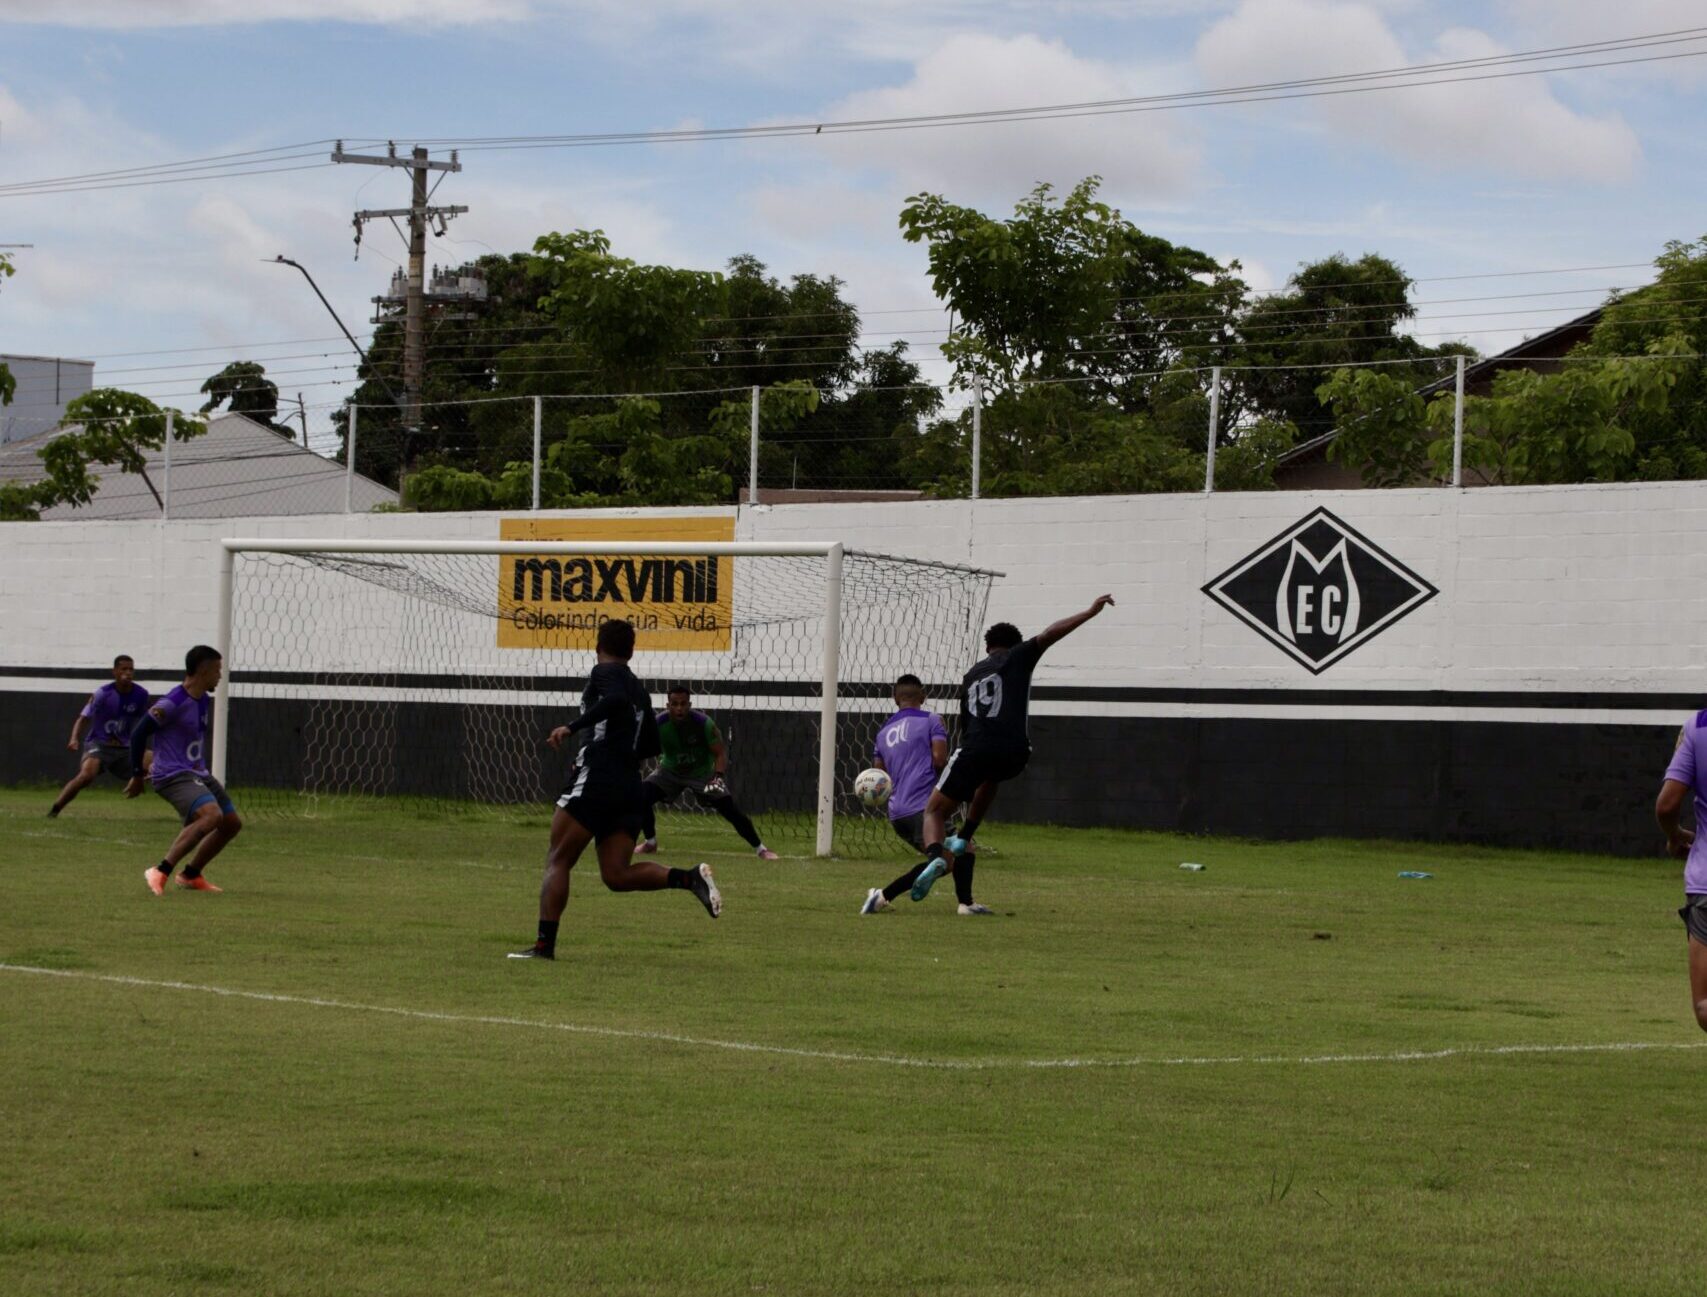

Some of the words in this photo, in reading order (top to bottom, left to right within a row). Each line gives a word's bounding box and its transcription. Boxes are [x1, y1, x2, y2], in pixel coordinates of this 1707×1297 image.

[513, 555, 718, 604] maxvinil
[674, 607, 717, 632] vida
[967, 672, 1003, 718] 19
